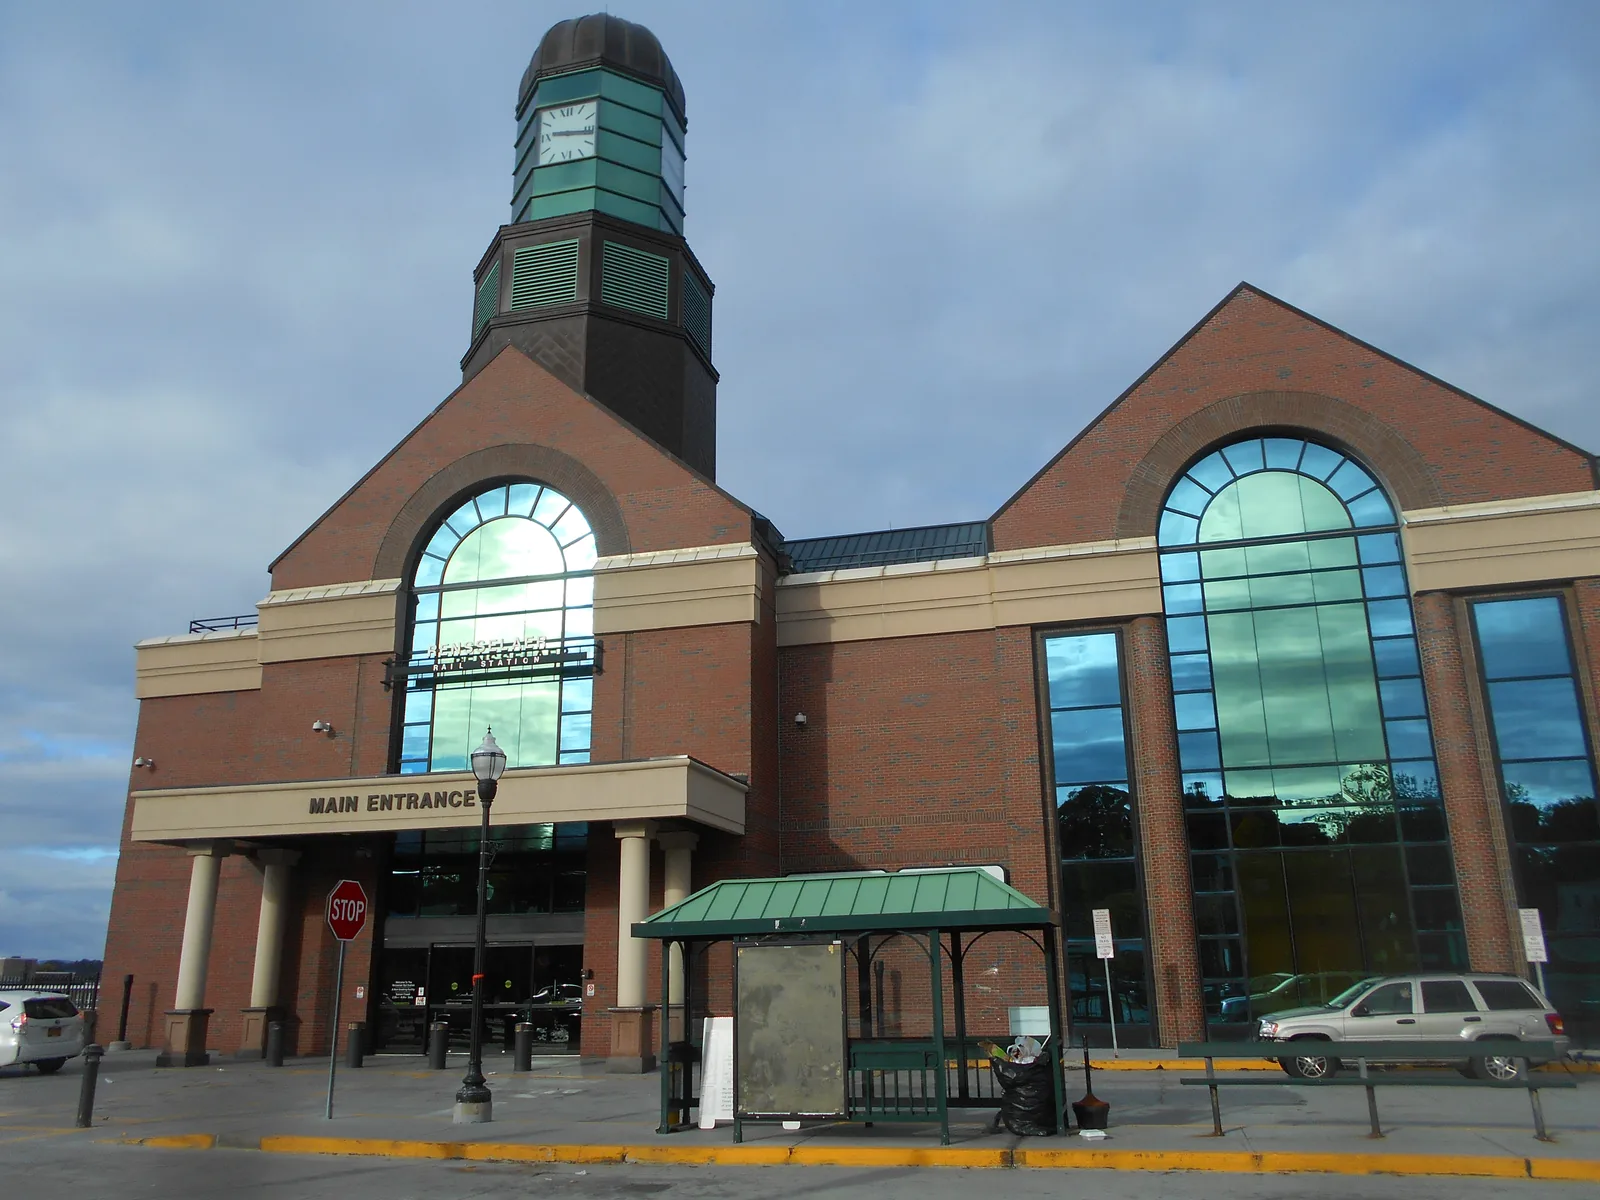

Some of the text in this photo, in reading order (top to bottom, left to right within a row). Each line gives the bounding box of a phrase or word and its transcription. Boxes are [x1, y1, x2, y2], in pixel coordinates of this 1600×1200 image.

[427, 636, 547, 658] RENSSELAER
[433, 656, 540, 671] RAIL STATION
[309, 790, 476, 814] MAIN ENTRANCE
[332, 898, 364, 922] STOP
